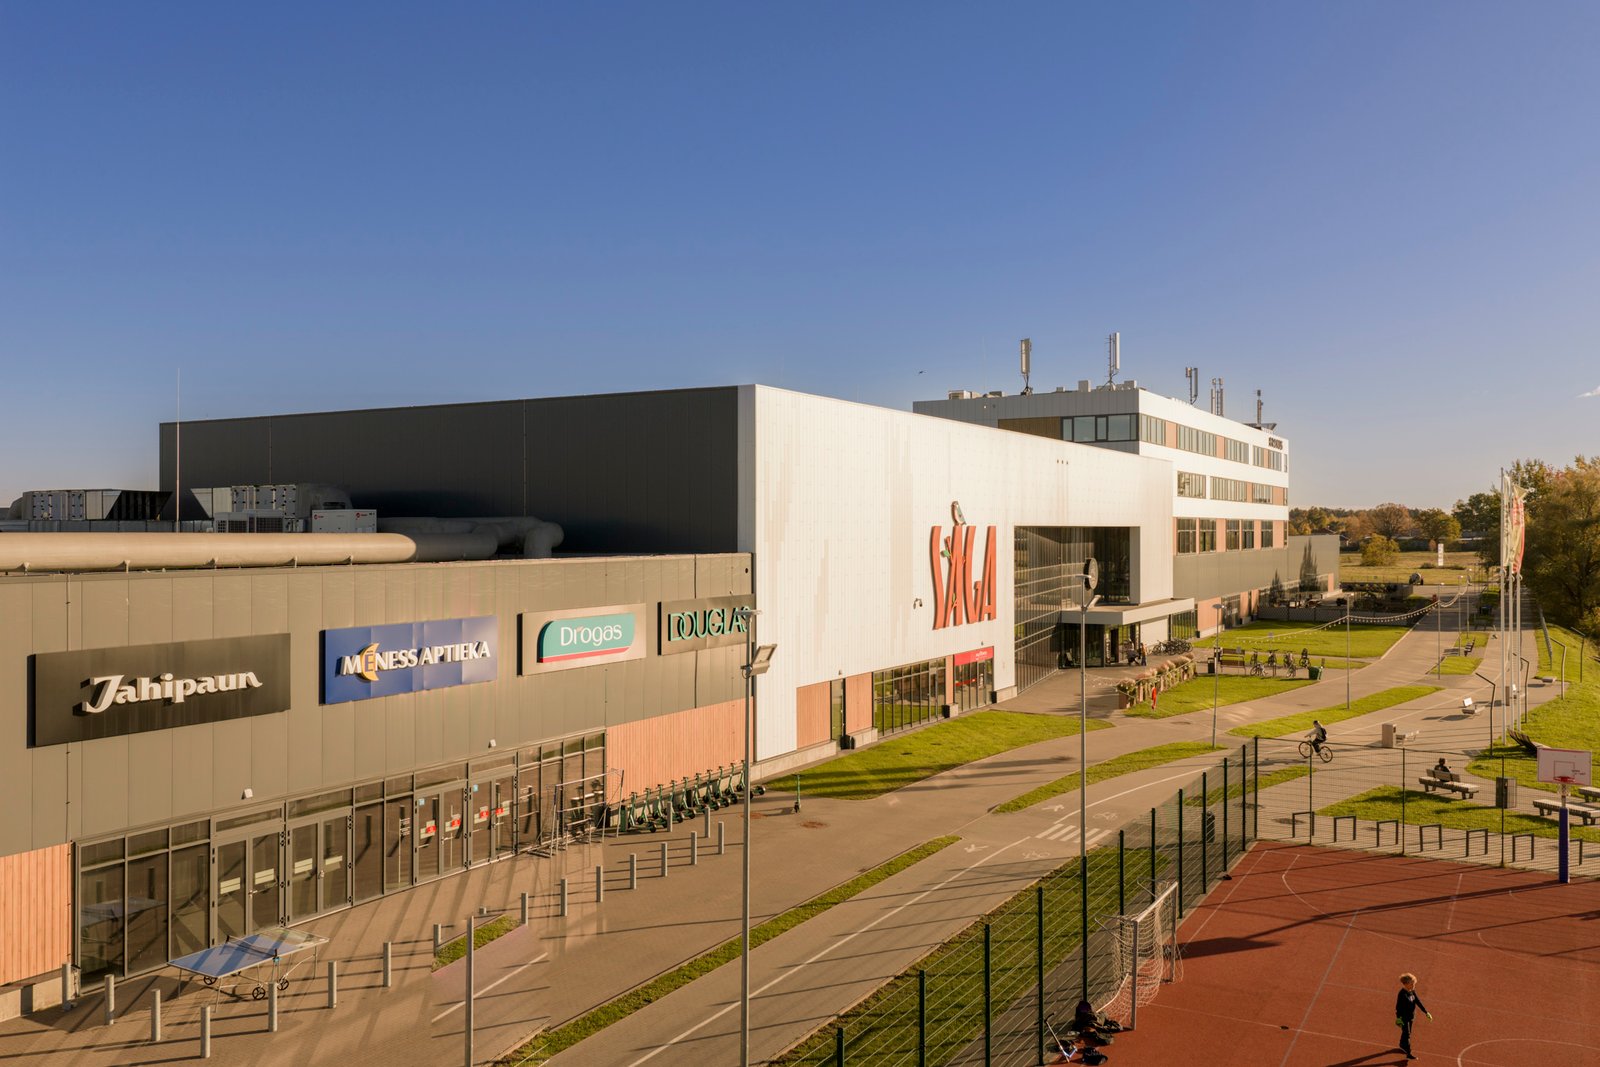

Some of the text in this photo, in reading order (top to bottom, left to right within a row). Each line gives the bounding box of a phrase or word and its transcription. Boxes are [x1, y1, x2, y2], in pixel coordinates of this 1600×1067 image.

[560, 623, 623, 647] Drogas
[421, 640, 491, 666] APTIEKA
[82, 671, 263, 713] Jahipaun
